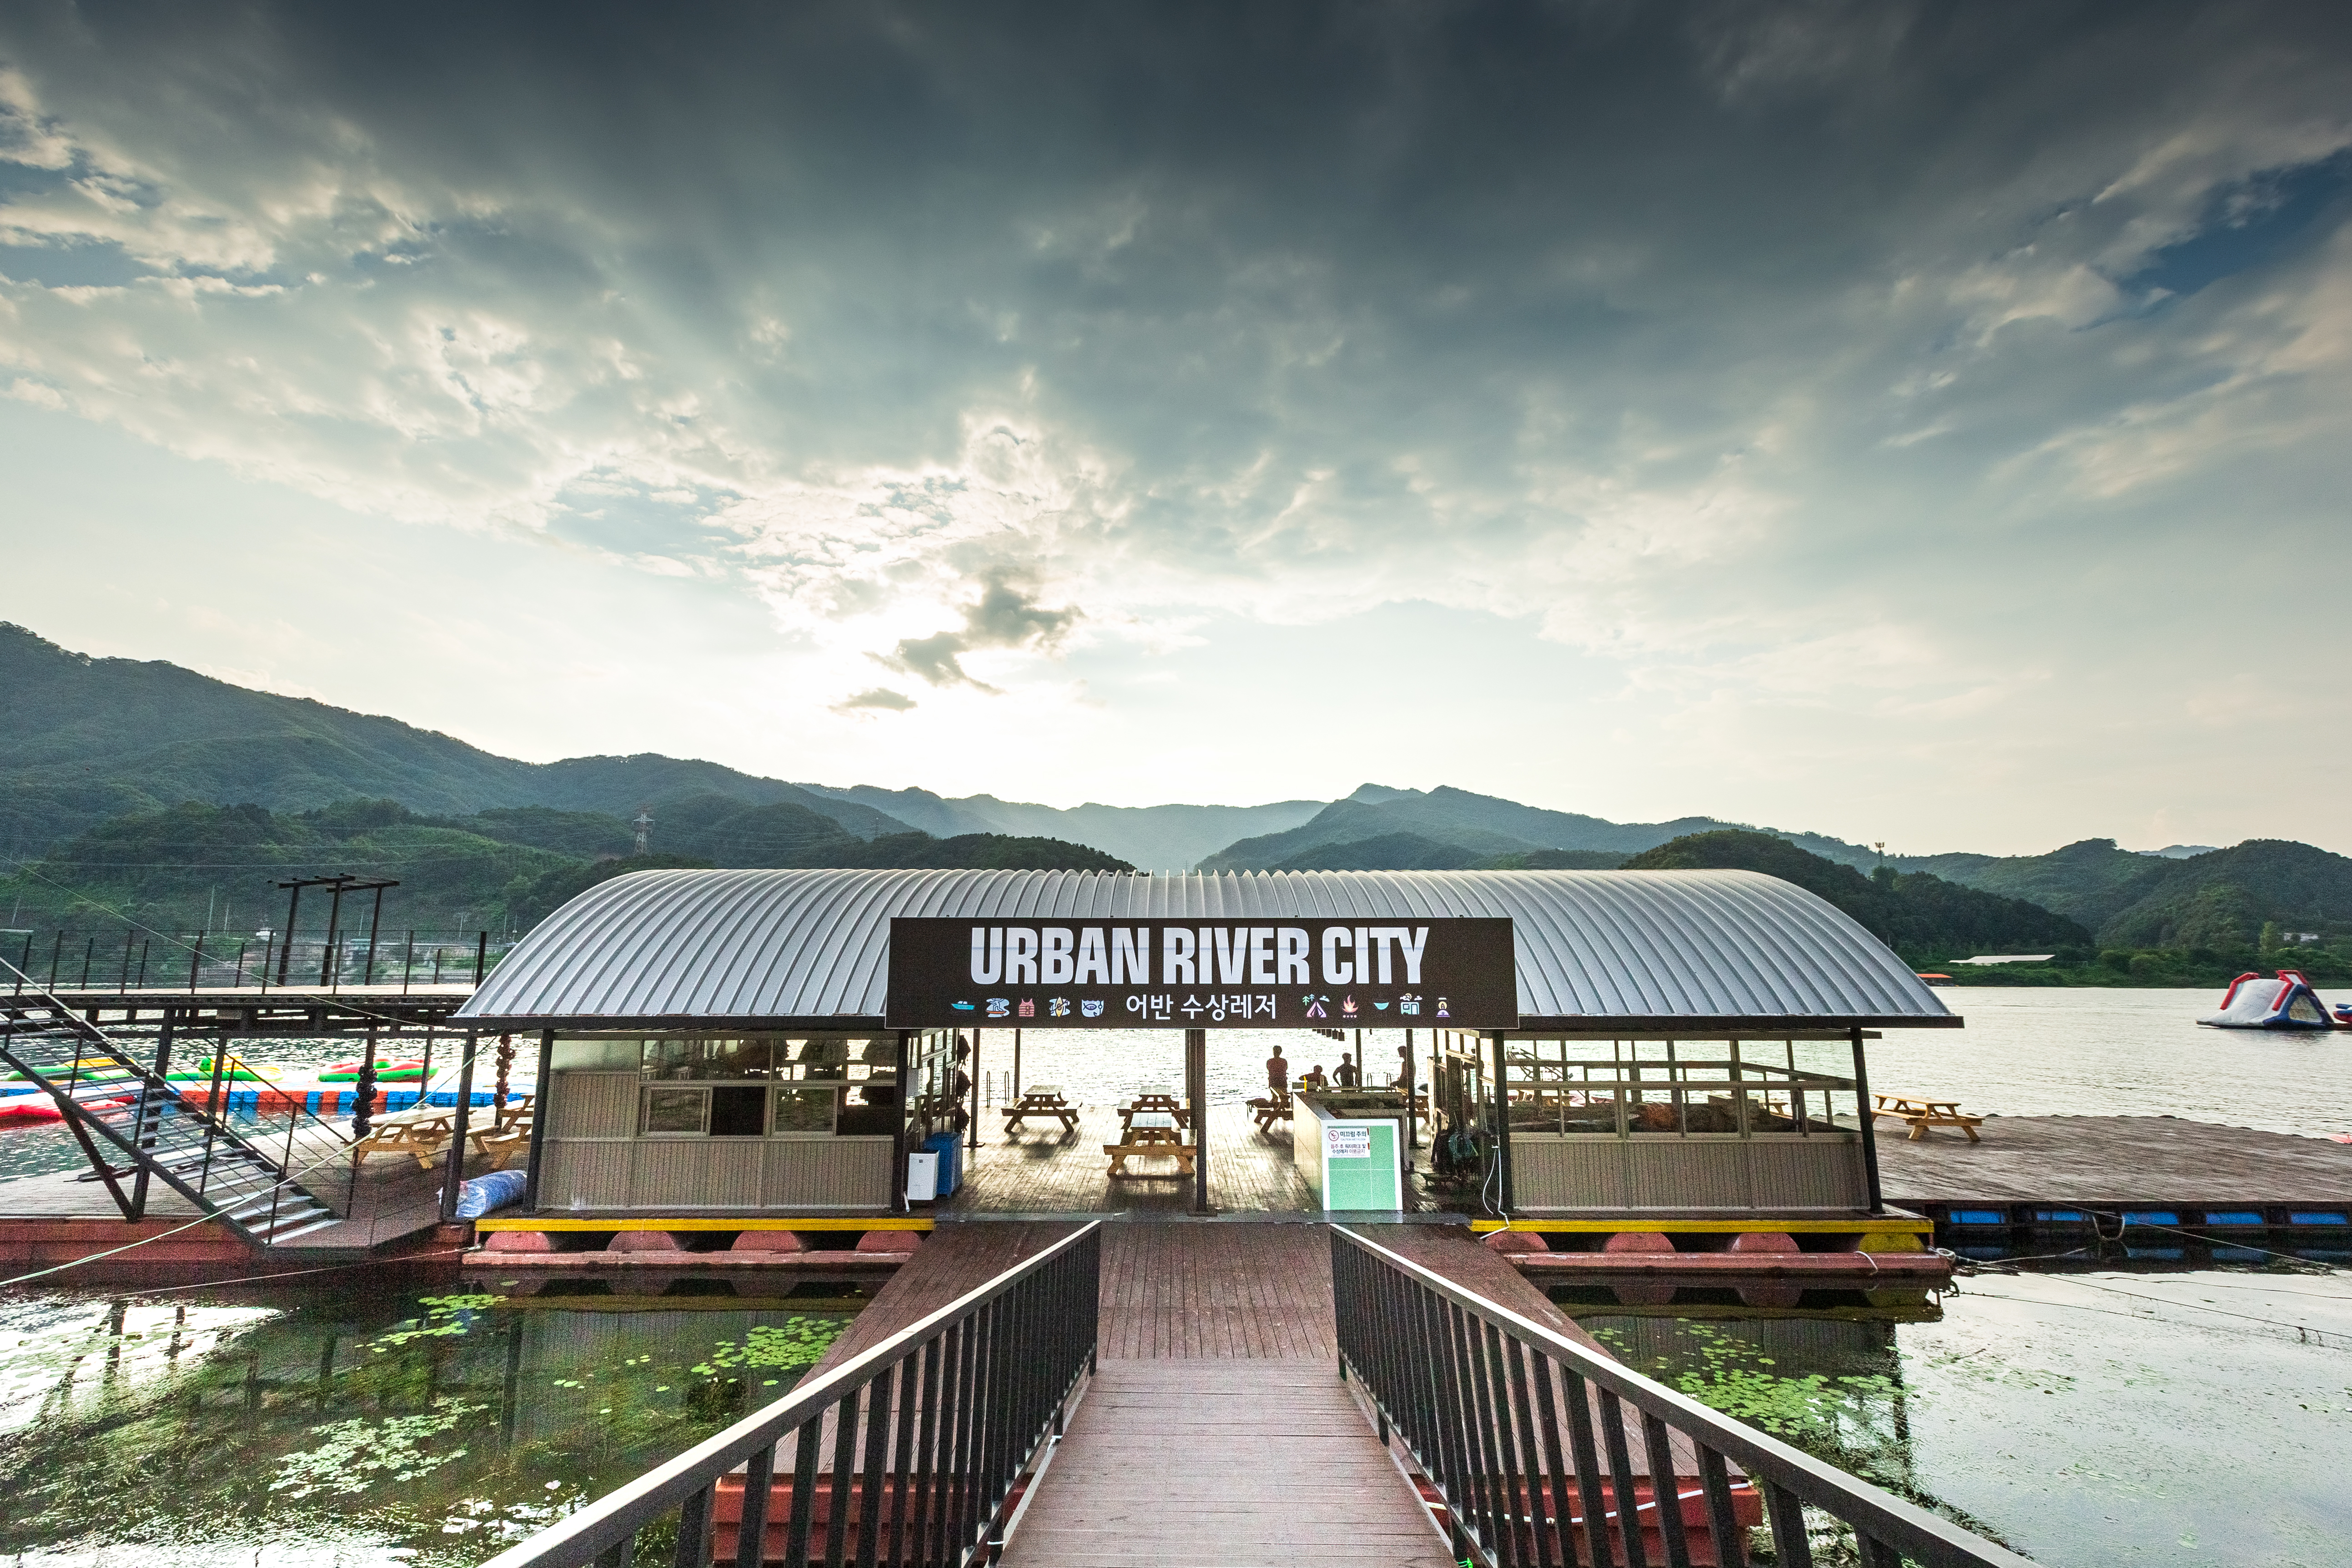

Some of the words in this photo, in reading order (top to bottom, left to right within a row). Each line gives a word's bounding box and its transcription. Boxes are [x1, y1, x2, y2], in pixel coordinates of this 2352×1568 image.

[970, 927, 1149, 985] URBAN
[1163, 927, 1310, 985] RIVER
[1322, 926, 1429, 985] CITY
[1126, 994, 1174, 1020] 어반
[1180, 994, 1276, 1022] 수상레저
